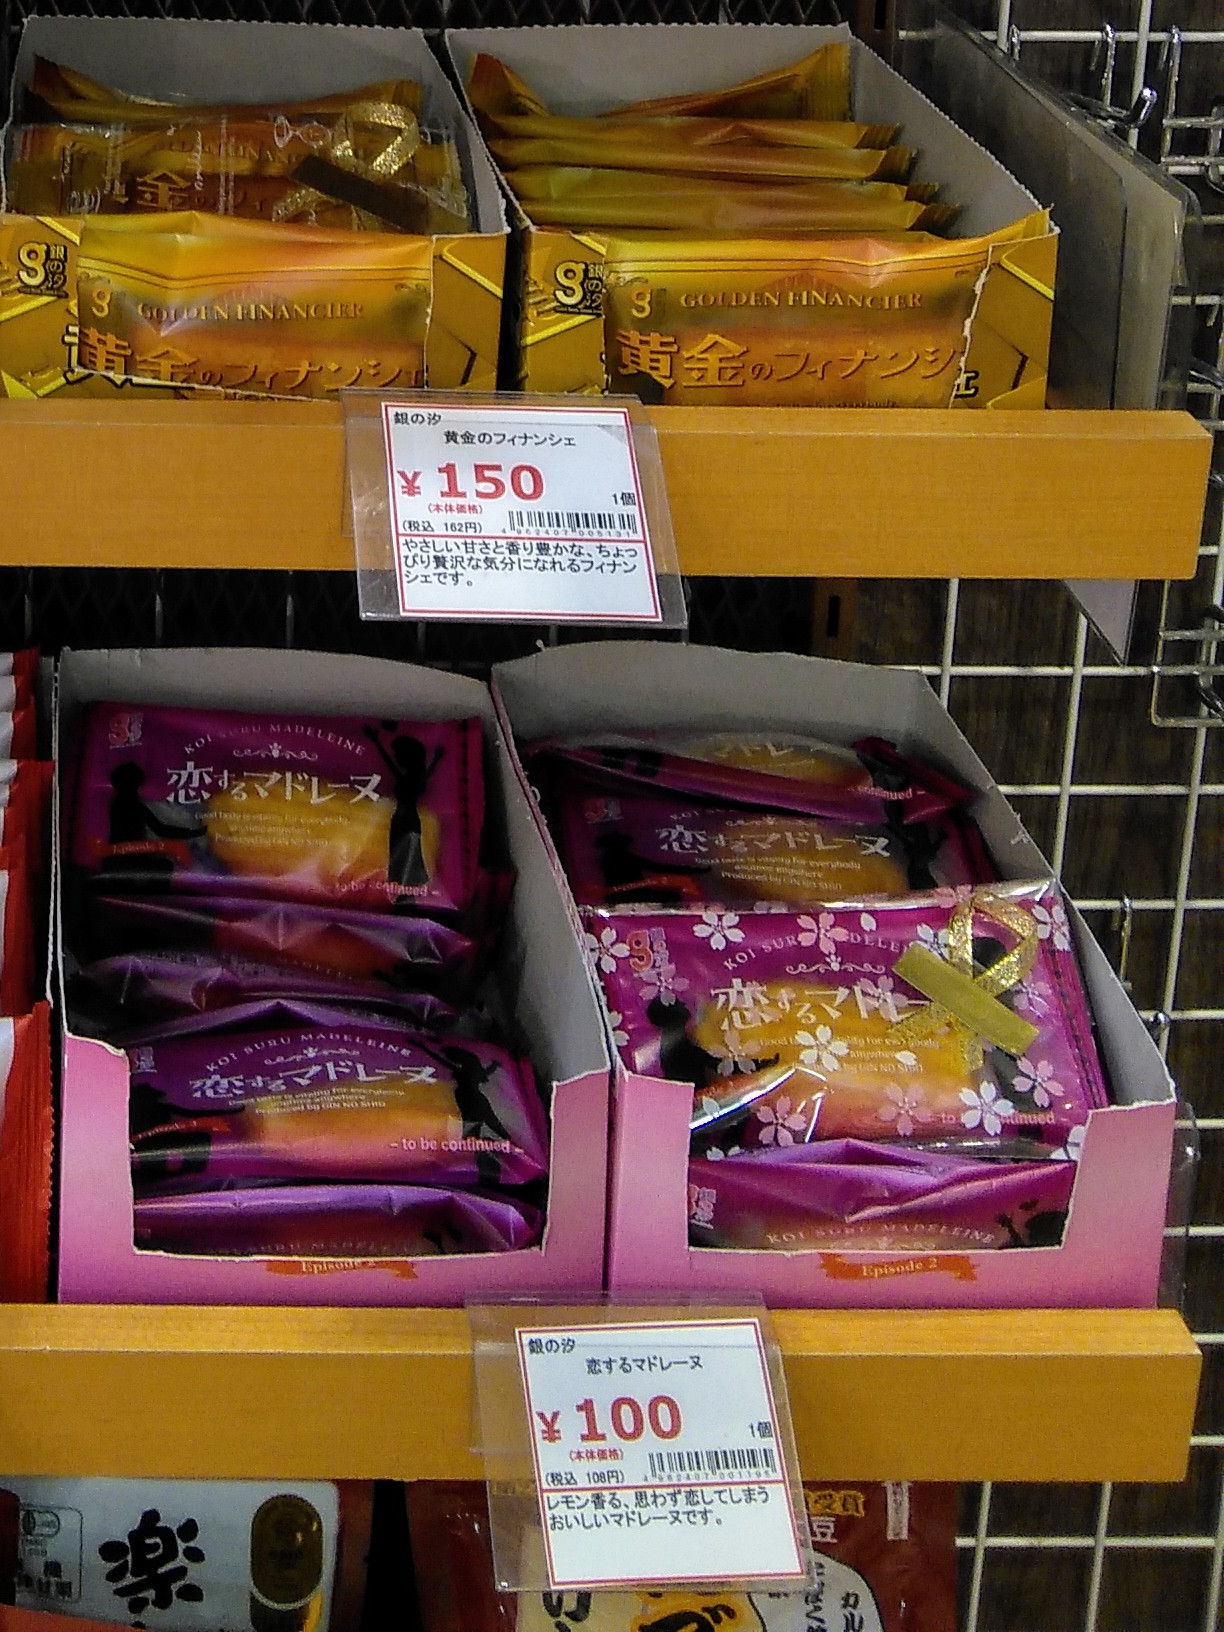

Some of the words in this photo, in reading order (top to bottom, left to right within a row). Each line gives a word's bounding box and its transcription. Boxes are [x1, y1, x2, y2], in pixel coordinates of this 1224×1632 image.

[394, 412, 442, 426] 銀の汐
[443, 431, 576, 446] 黄金のフィナンシェ
[612, 492, 636, 506] 1個
[427, 503, 483, 515] (本体価格)
[403, 541, 638, 558] やさしい甘さと香り豊かな、ちょっ
[404, 556, 637, 574] ぴり贅沢な気分になれるフィナン
[404, 570, 473, 587] シェです。
[166, 761, 382, 804] 恋するマドレーヌ
[528, 1338, 575, 1354] 銀の汐
[586, 1356, 703, 1375] 恋するマドレーヌ
[749, 1422, 773, 1439] 1個
[569, 1449, 624, 1461] (本体価格)
[546, 1489, 770, 1511] レモン香る、思わず恋してしまう
[549, 1510, 723, 1531] おいしいマドレーヌです。
[98, 1509, 206, 1614] 楽
